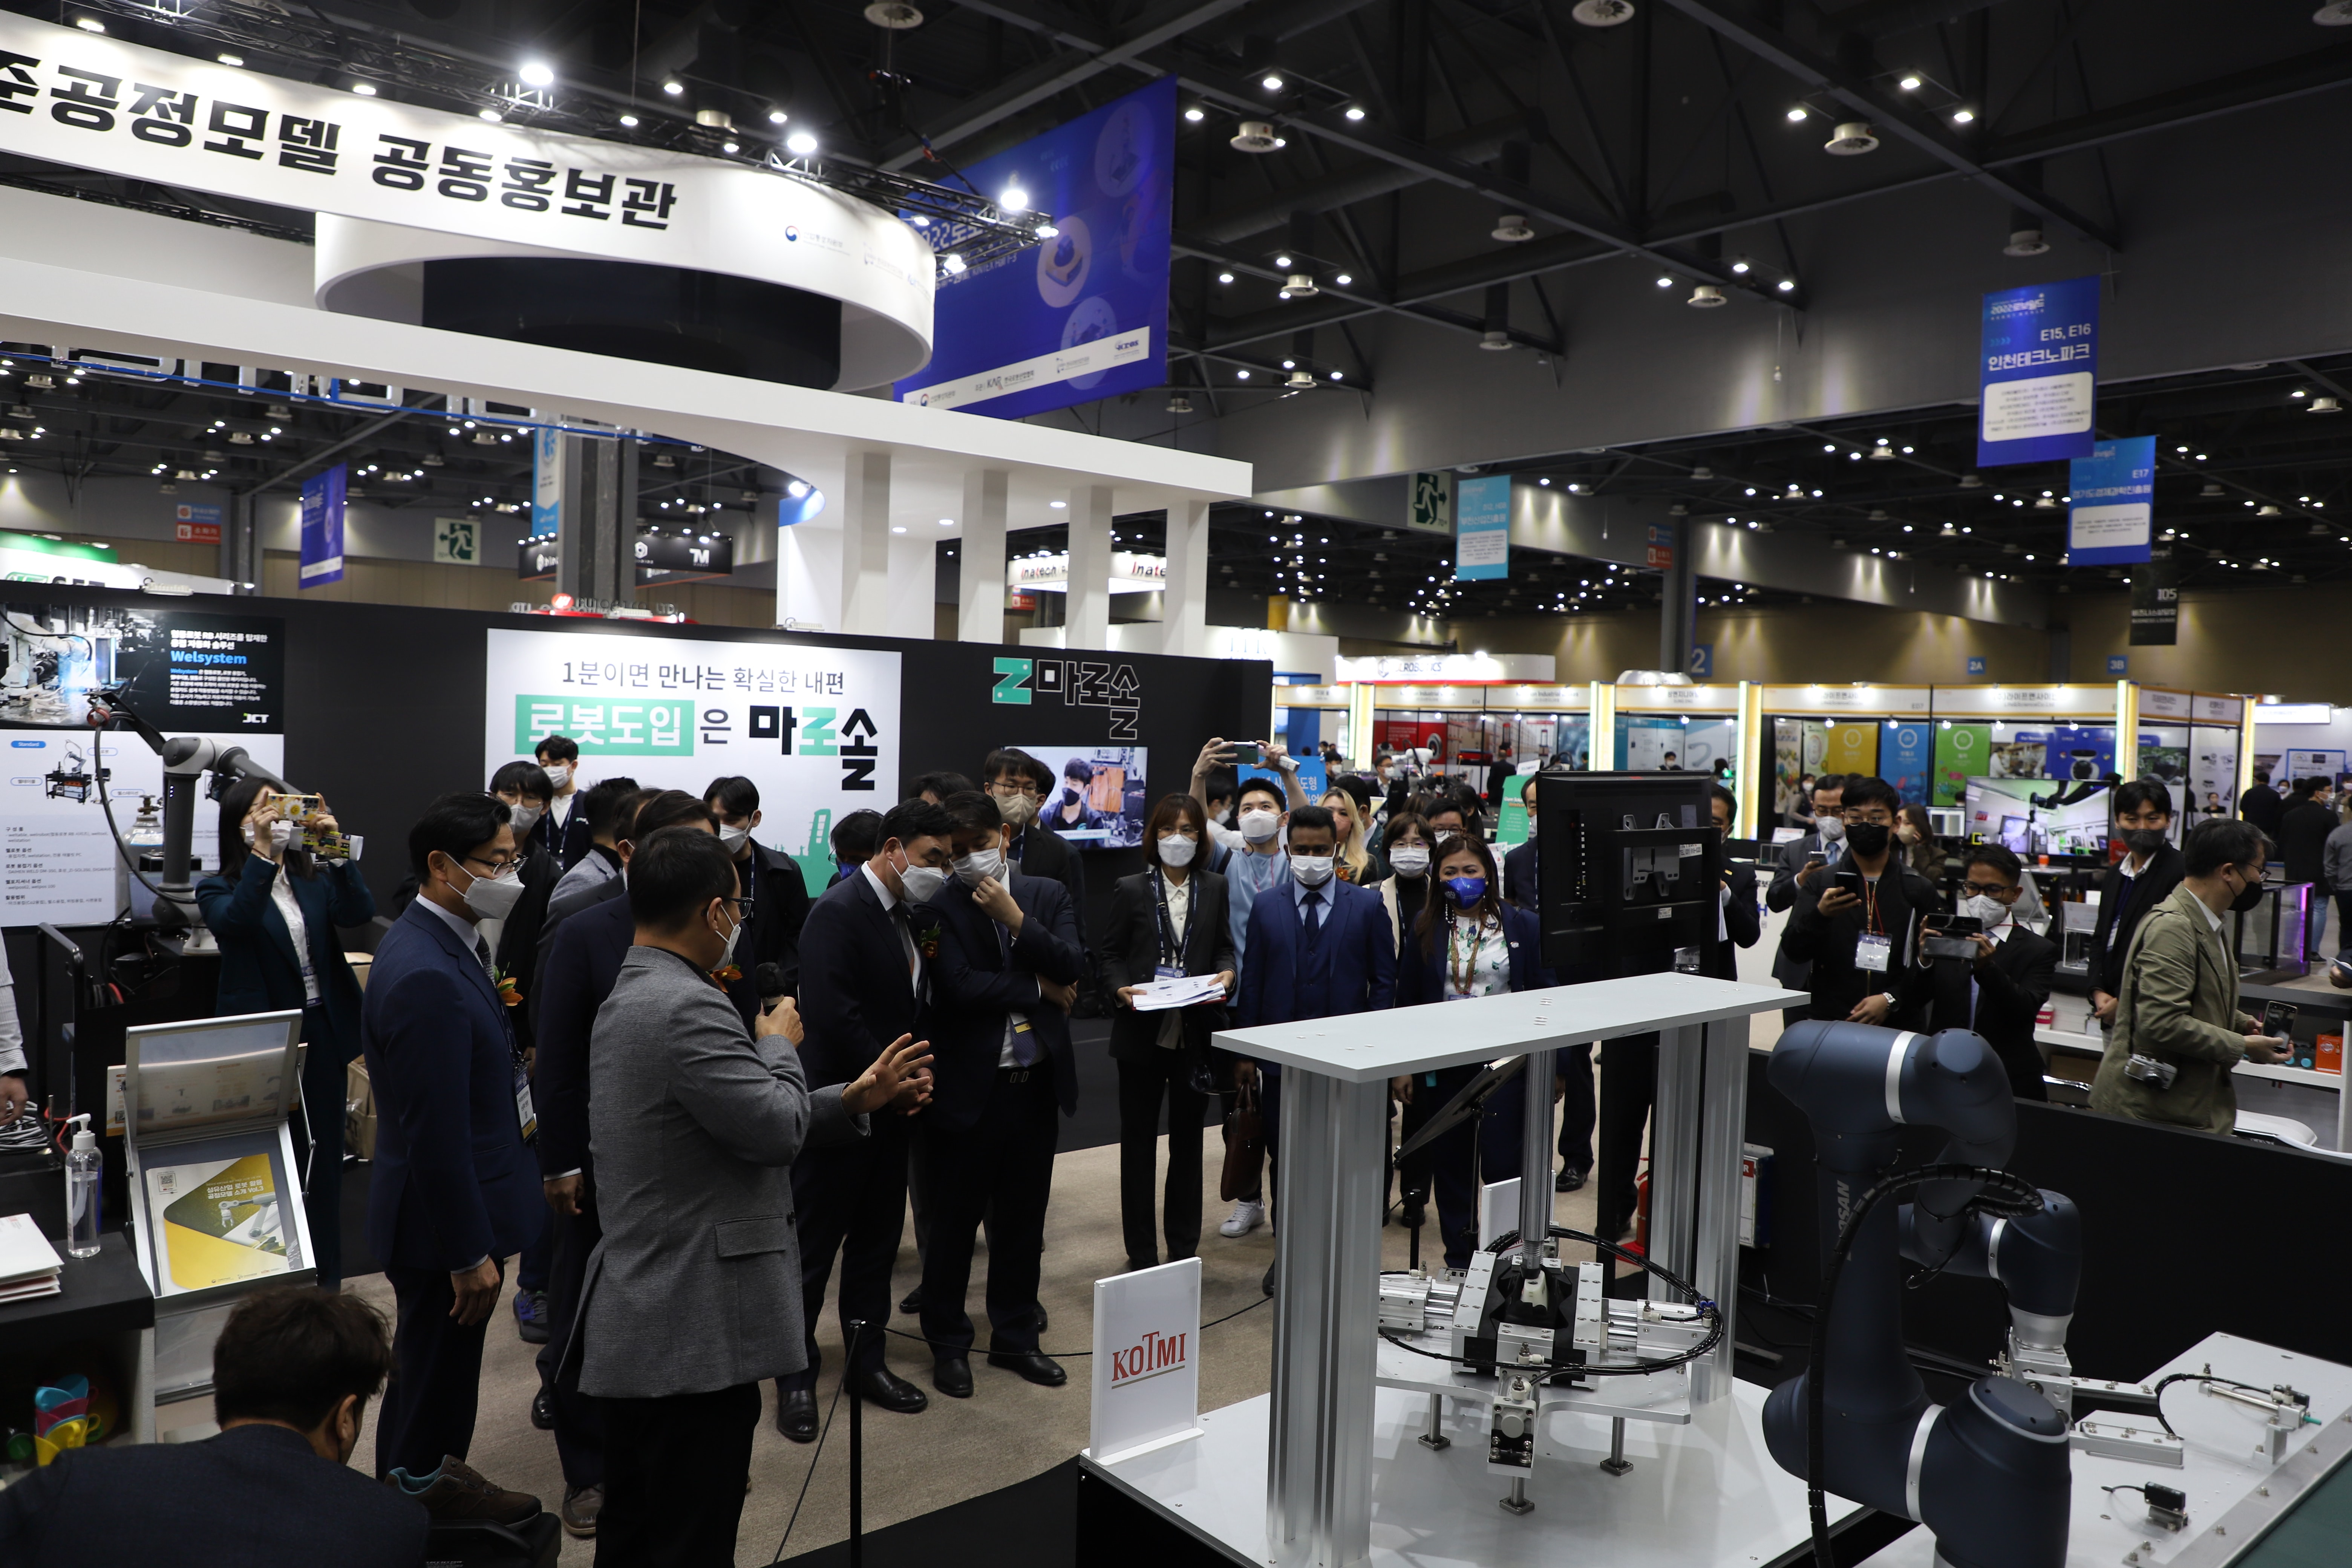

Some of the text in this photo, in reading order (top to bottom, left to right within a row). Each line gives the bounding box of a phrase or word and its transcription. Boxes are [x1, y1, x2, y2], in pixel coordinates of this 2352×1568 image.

[372, 134, 677, 230] 공동홍보관
[2040, 323, 2092, 342] E15, E16
[1988, 343, 2090, 372] 인천테크노파크
[2132, 469, 2149, 479] E17
[1021, 565, 1056, 578] Inatech
[170, 650, 247, 666] Welsystem
[1692, 648, 1705, 673] 2
[1970, 661, 1983, 671] 2A
[2110, 660, 2124, 670] 3B
[562, 661, 844, 695] 1분이면 만나는 확실한 내편
[528, 702, 732, 747] 로봇도입 은
[207, 1184, 233, 1193] 섬유산업
[208, 1191, 233, 1199] 공정모델
[1111, 1331, 1187, 1382] KOTMI
